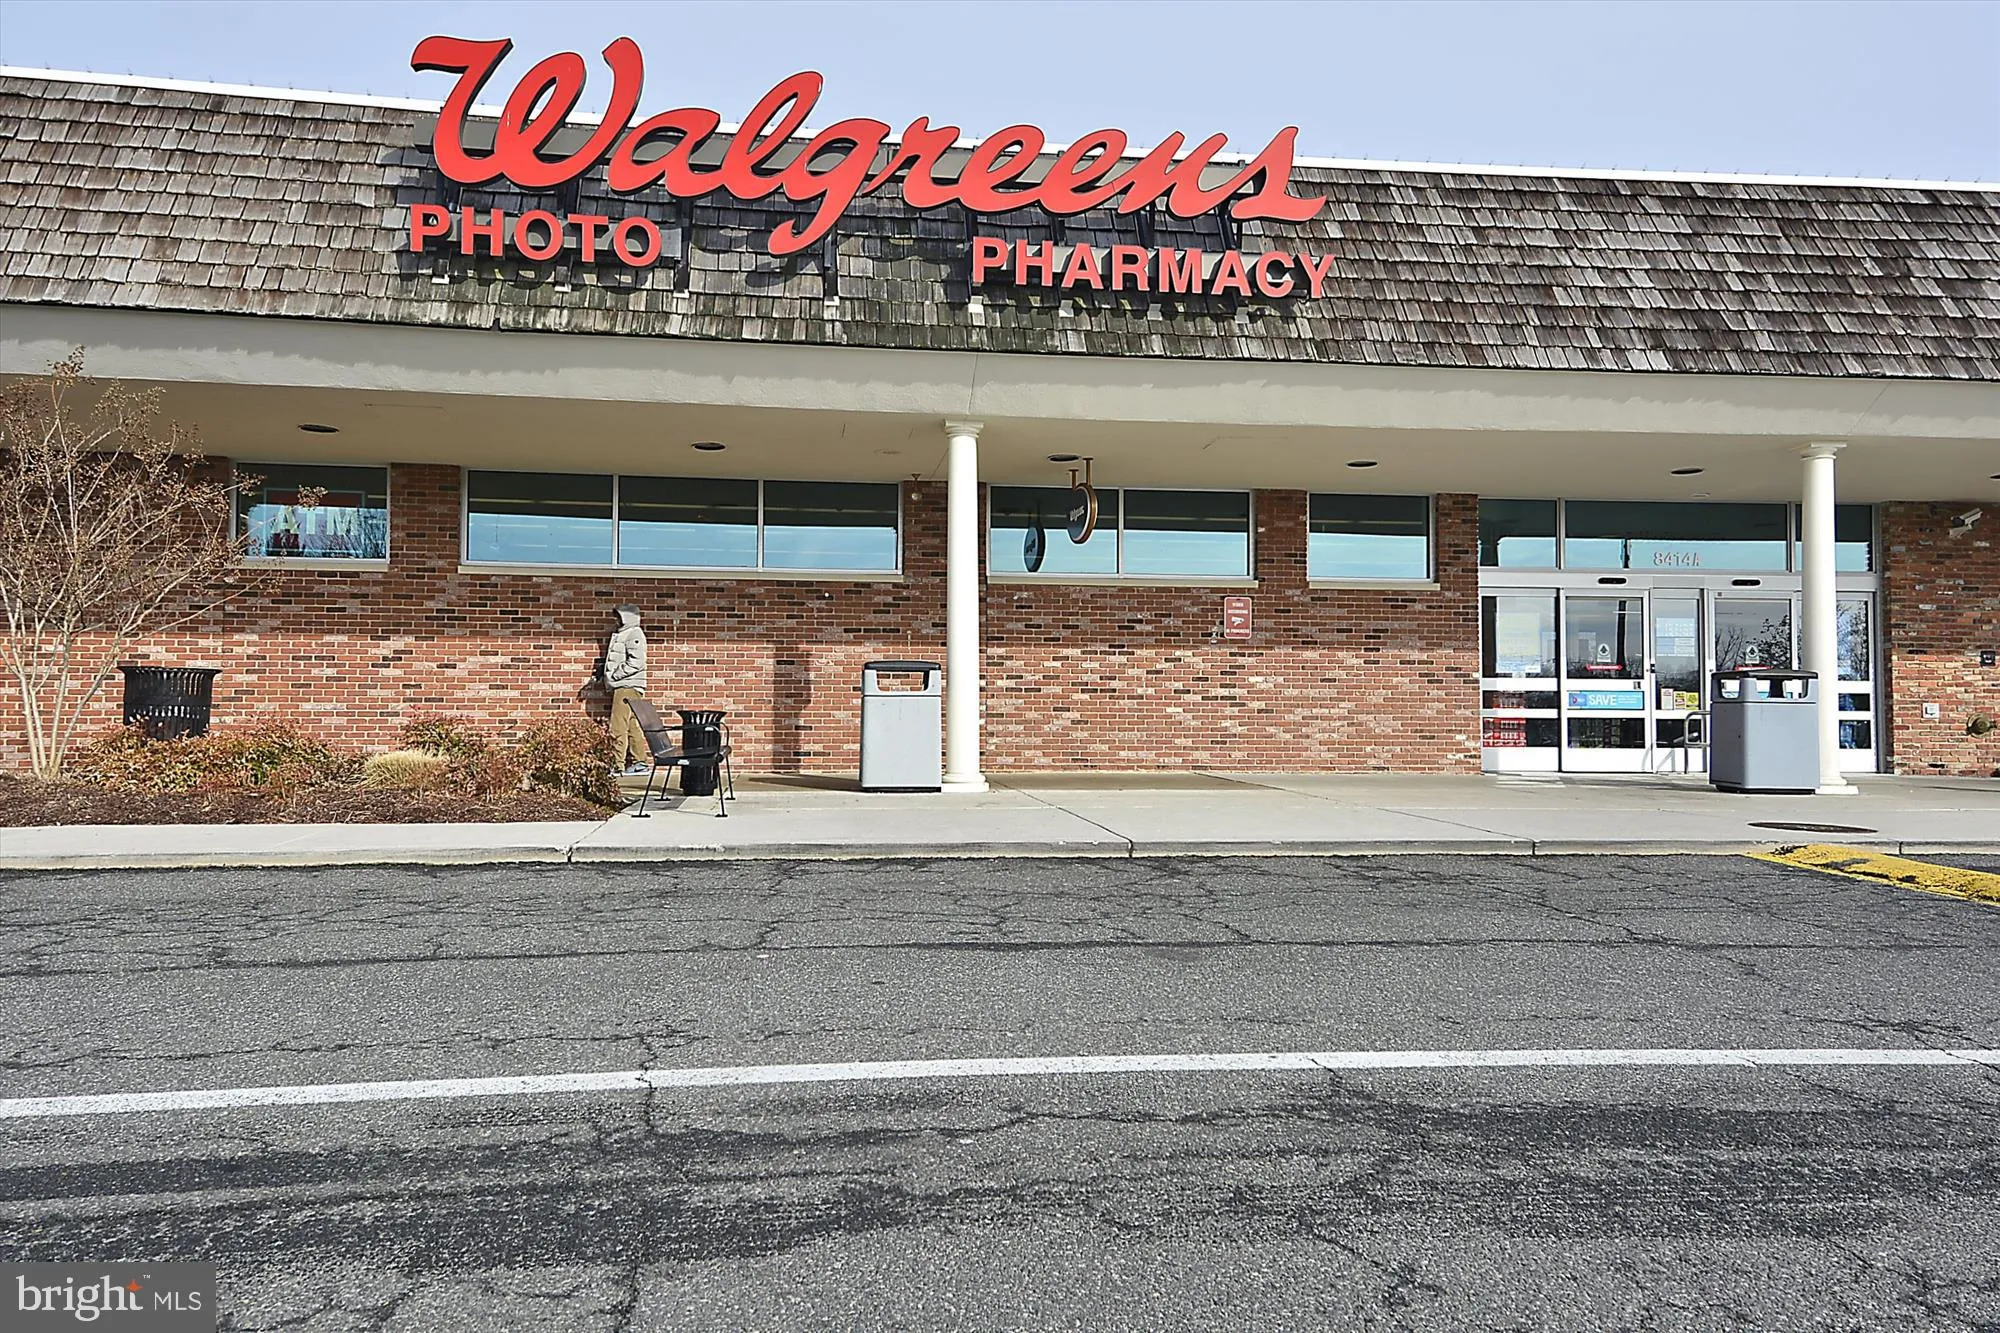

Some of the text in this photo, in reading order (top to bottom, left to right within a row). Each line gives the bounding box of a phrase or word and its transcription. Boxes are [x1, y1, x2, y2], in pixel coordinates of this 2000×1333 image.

[411, 36, 1327, 256] Walgreens
[410, 203, 663, 268] PHOTO
[972, 236, 1335, 299] PHARMACY
[271, 504, 359, 536] ATM
[1588, 694, 1617, 706] SAVE
